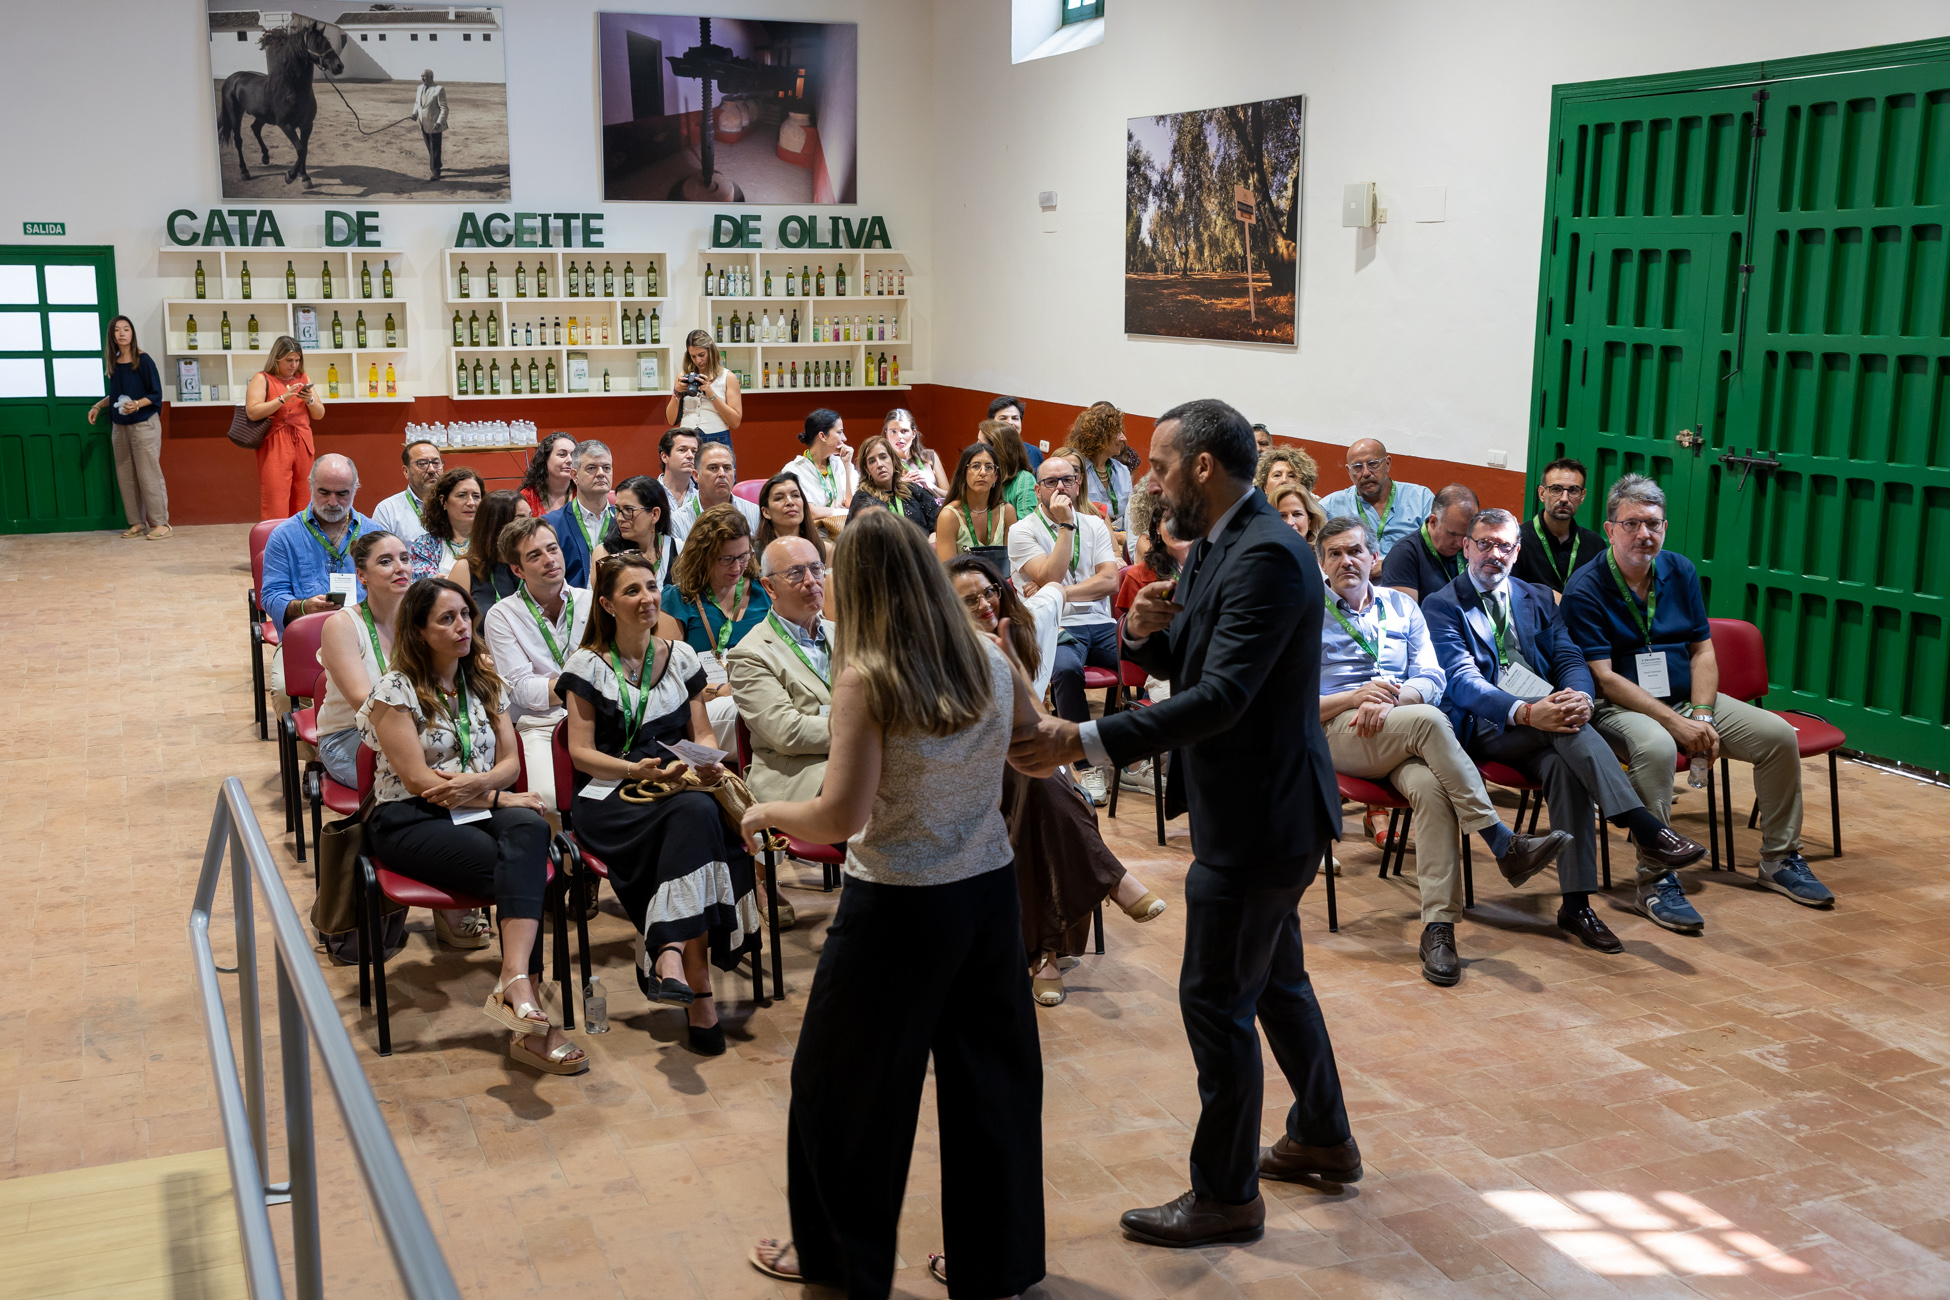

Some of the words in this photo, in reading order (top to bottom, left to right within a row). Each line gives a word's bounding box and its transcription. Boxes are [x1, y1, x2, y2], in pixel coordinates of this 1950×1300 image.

[25, 223, 63, 234] SALIDA
[167, 209, 285, 246] CATA
[325, 210, 381, 247] DE
[454, 212, 604, 248] ACEITE
[712, 214, 762, 248] DE
[778, 215, 892, 249] OLIVA
